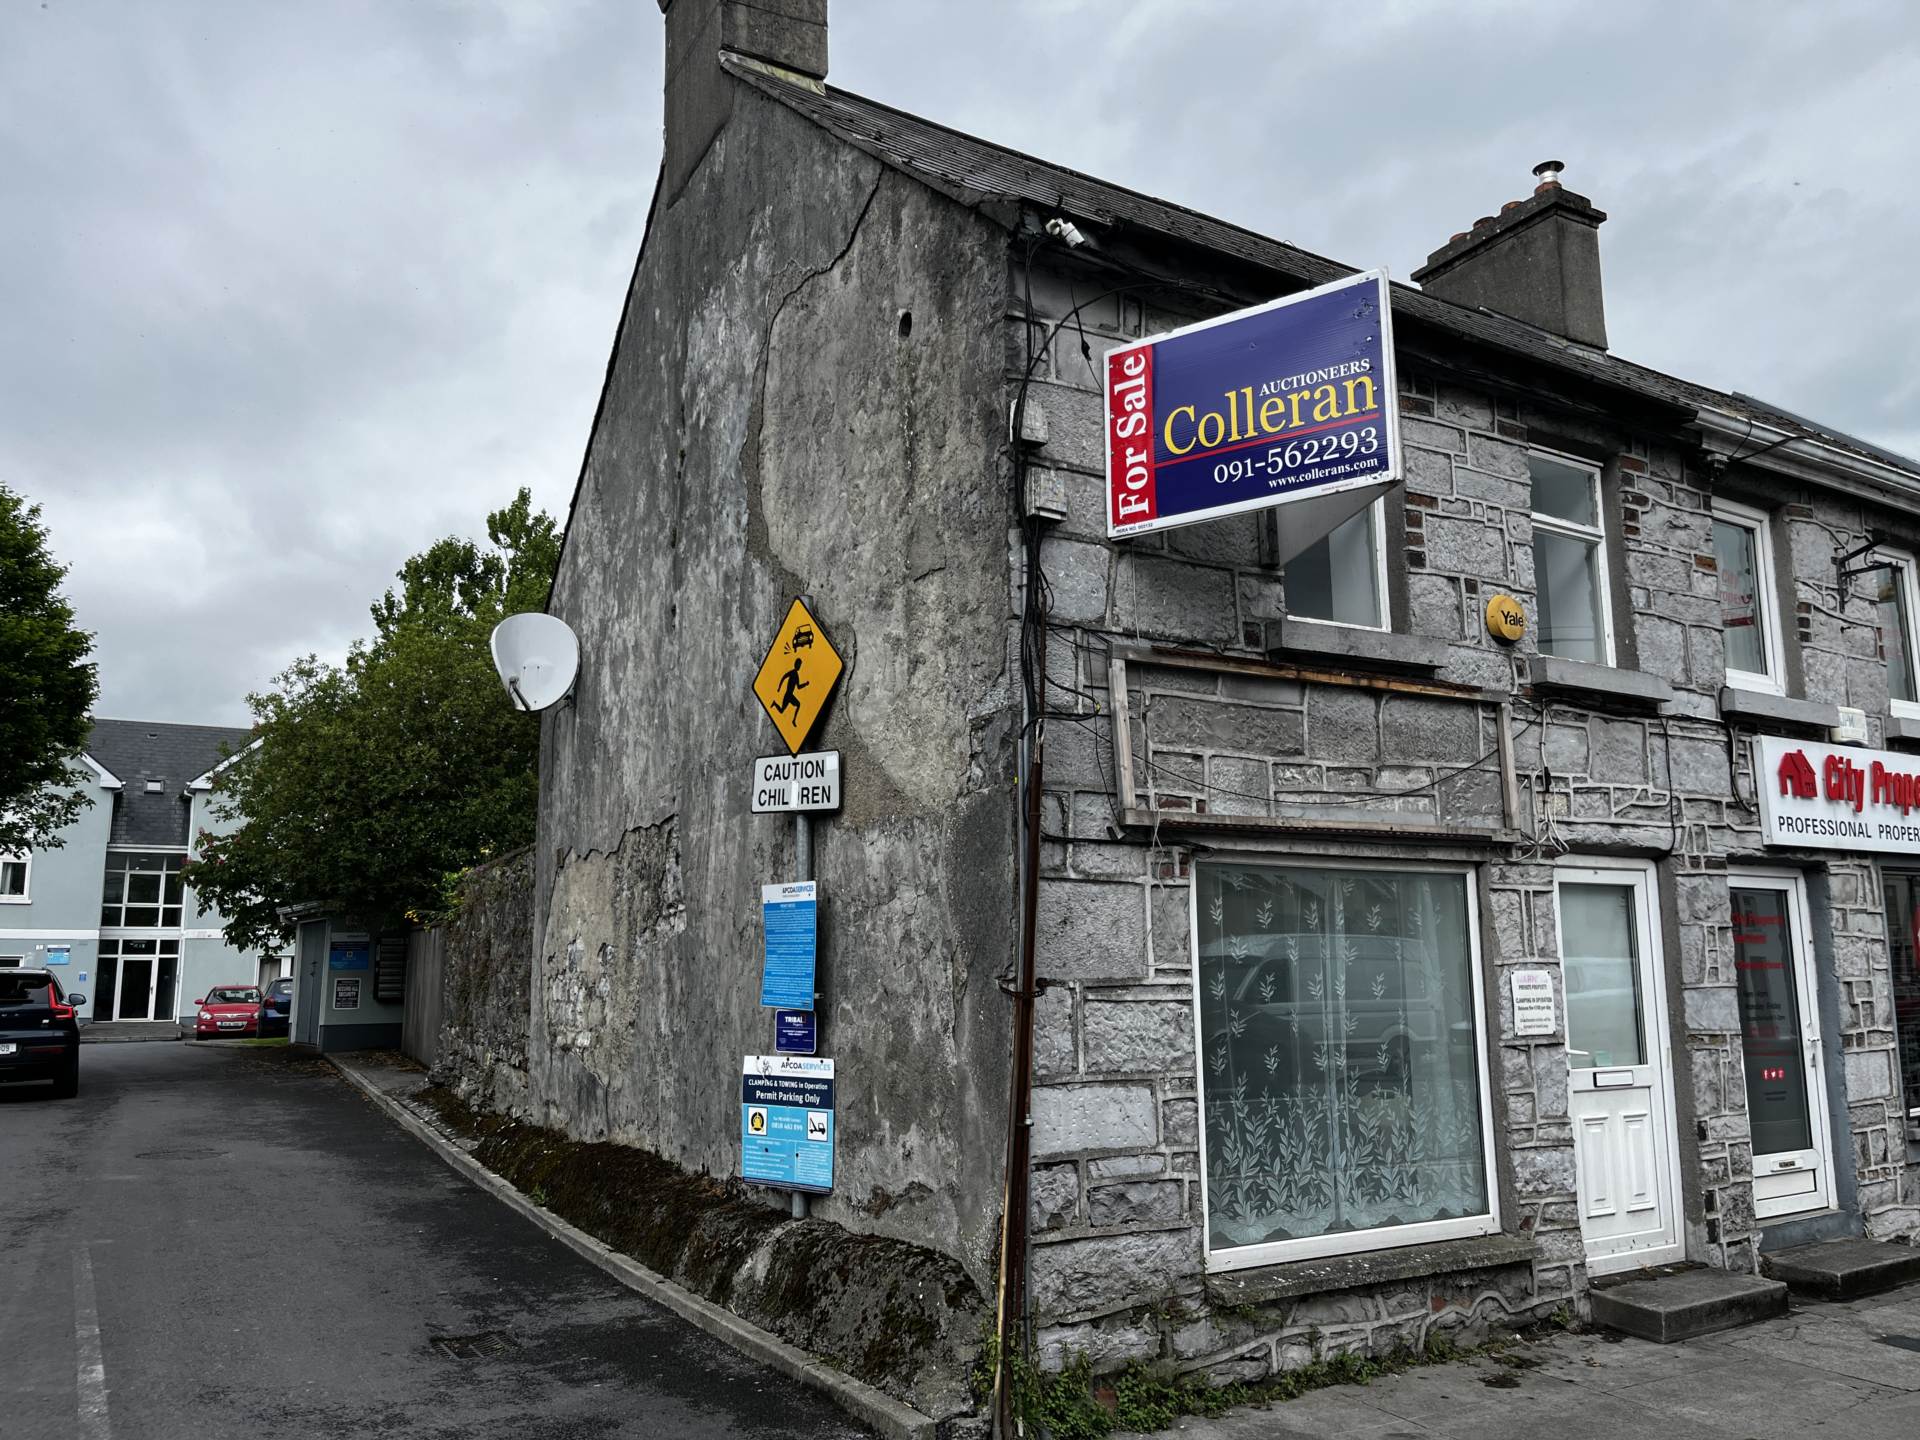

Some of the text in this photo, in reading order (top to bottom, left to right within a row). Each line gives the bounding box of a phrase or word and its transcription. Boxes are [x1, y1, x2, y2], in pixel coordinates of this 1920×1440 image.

[1259, 358, 1370, 397] AUCTIONEERS
[1164, 374, 1379, 455] Colleran
[1114, 353, 1150, 520] For Sale
[1214, 427, 1379, 484] 091-562293
[1268, 457, 1379, 489] www.collerans.com
[1501, 609, 1524, 627] Yale
[763, 759, 825, 782] CAUTION
[1824, 753, 1865, 813] City
[758, 784, 831, 807] CHILREN
[1778, 815, 1872, 839] PROFESSIONAL
[748, 1079, 773, 1087] CLAMPING
[804, 1082, 828, 1091] Operation
[755, 1090, 821, 1106] Permit Parking Only
